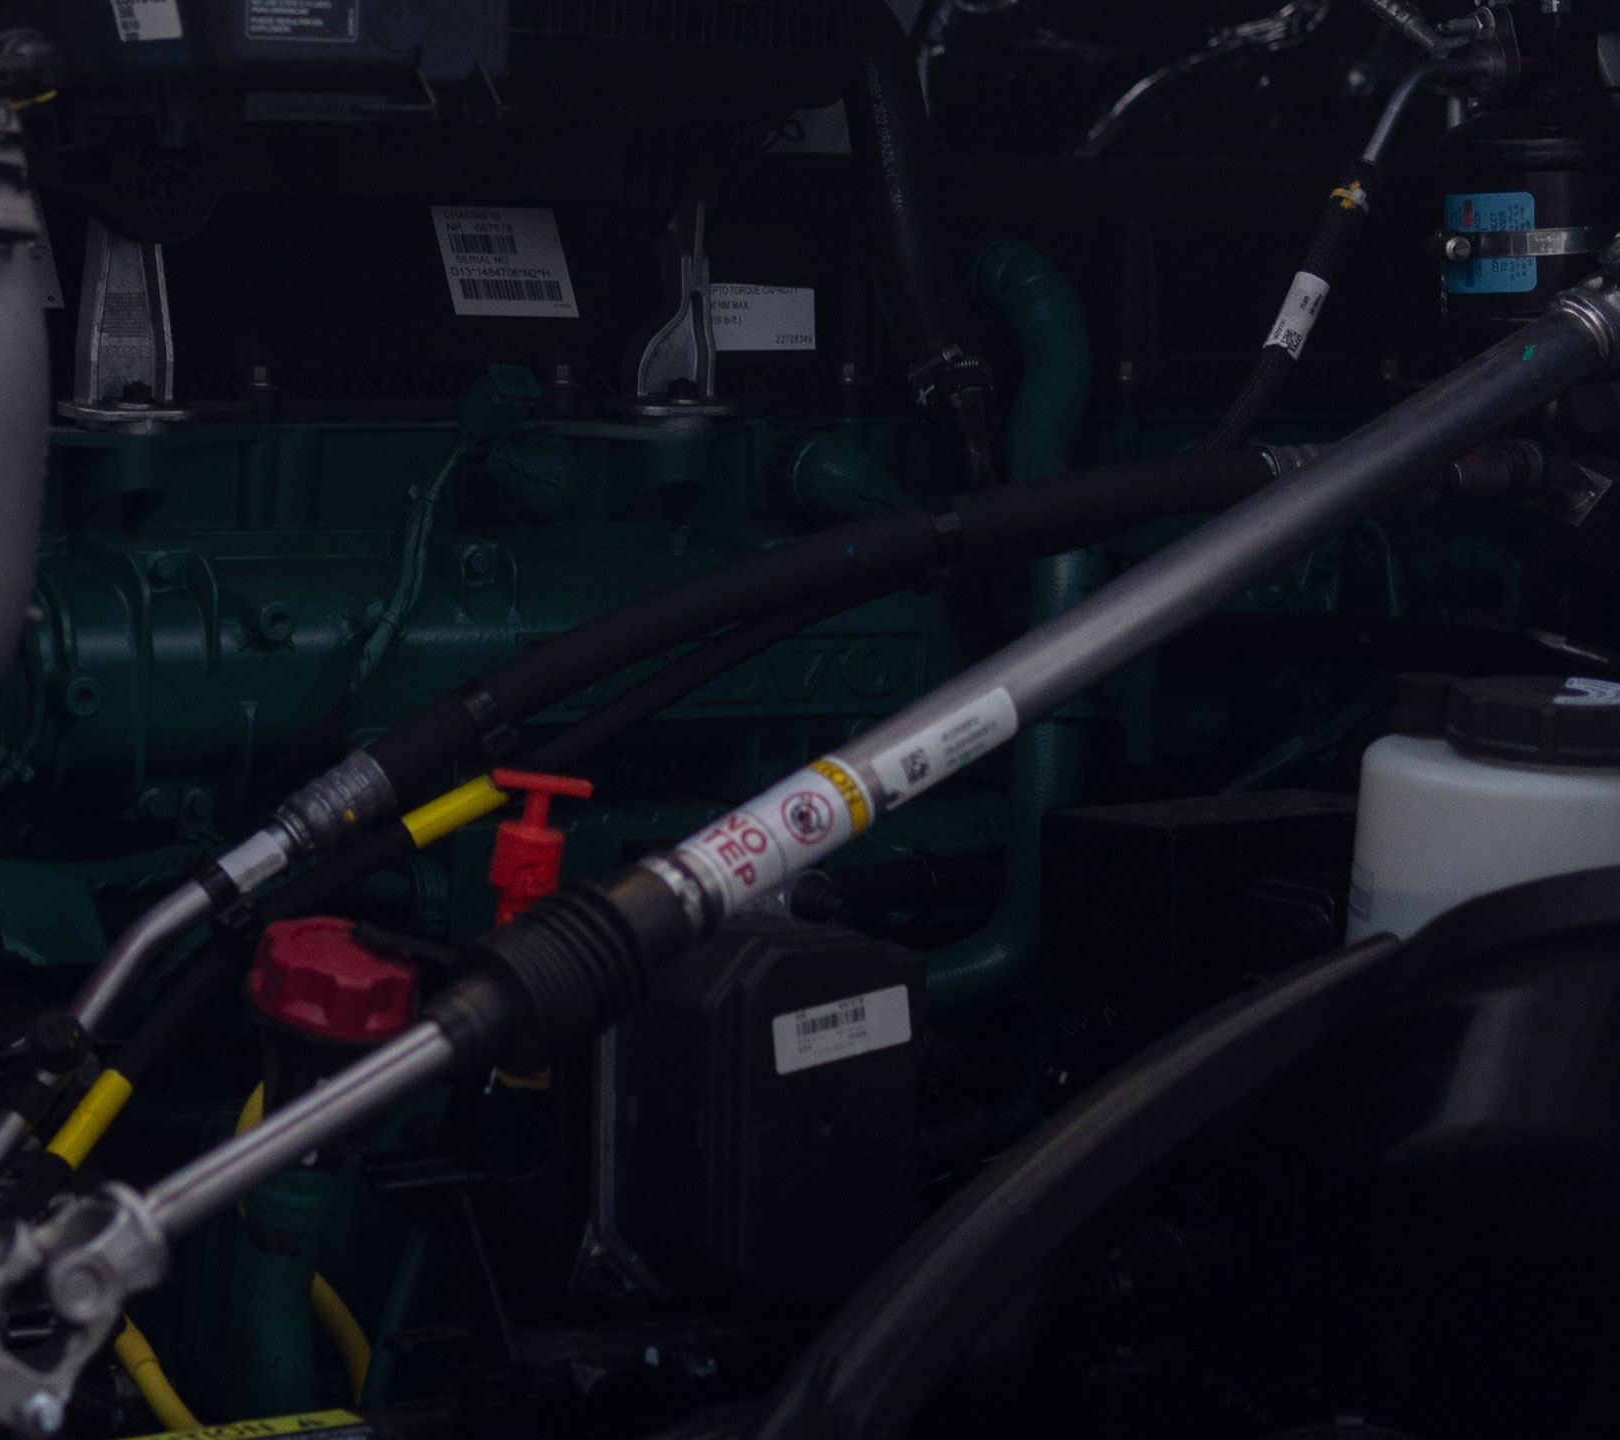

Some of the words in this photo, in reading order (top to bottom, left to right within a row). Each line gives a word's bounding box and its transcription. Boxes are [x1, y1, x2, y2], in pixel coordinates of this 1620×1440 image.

[456, 255, 491, 264] SERIAL
[730, 285, 760, 296] TORQUE
[731, 300, 749, 310] MAX
